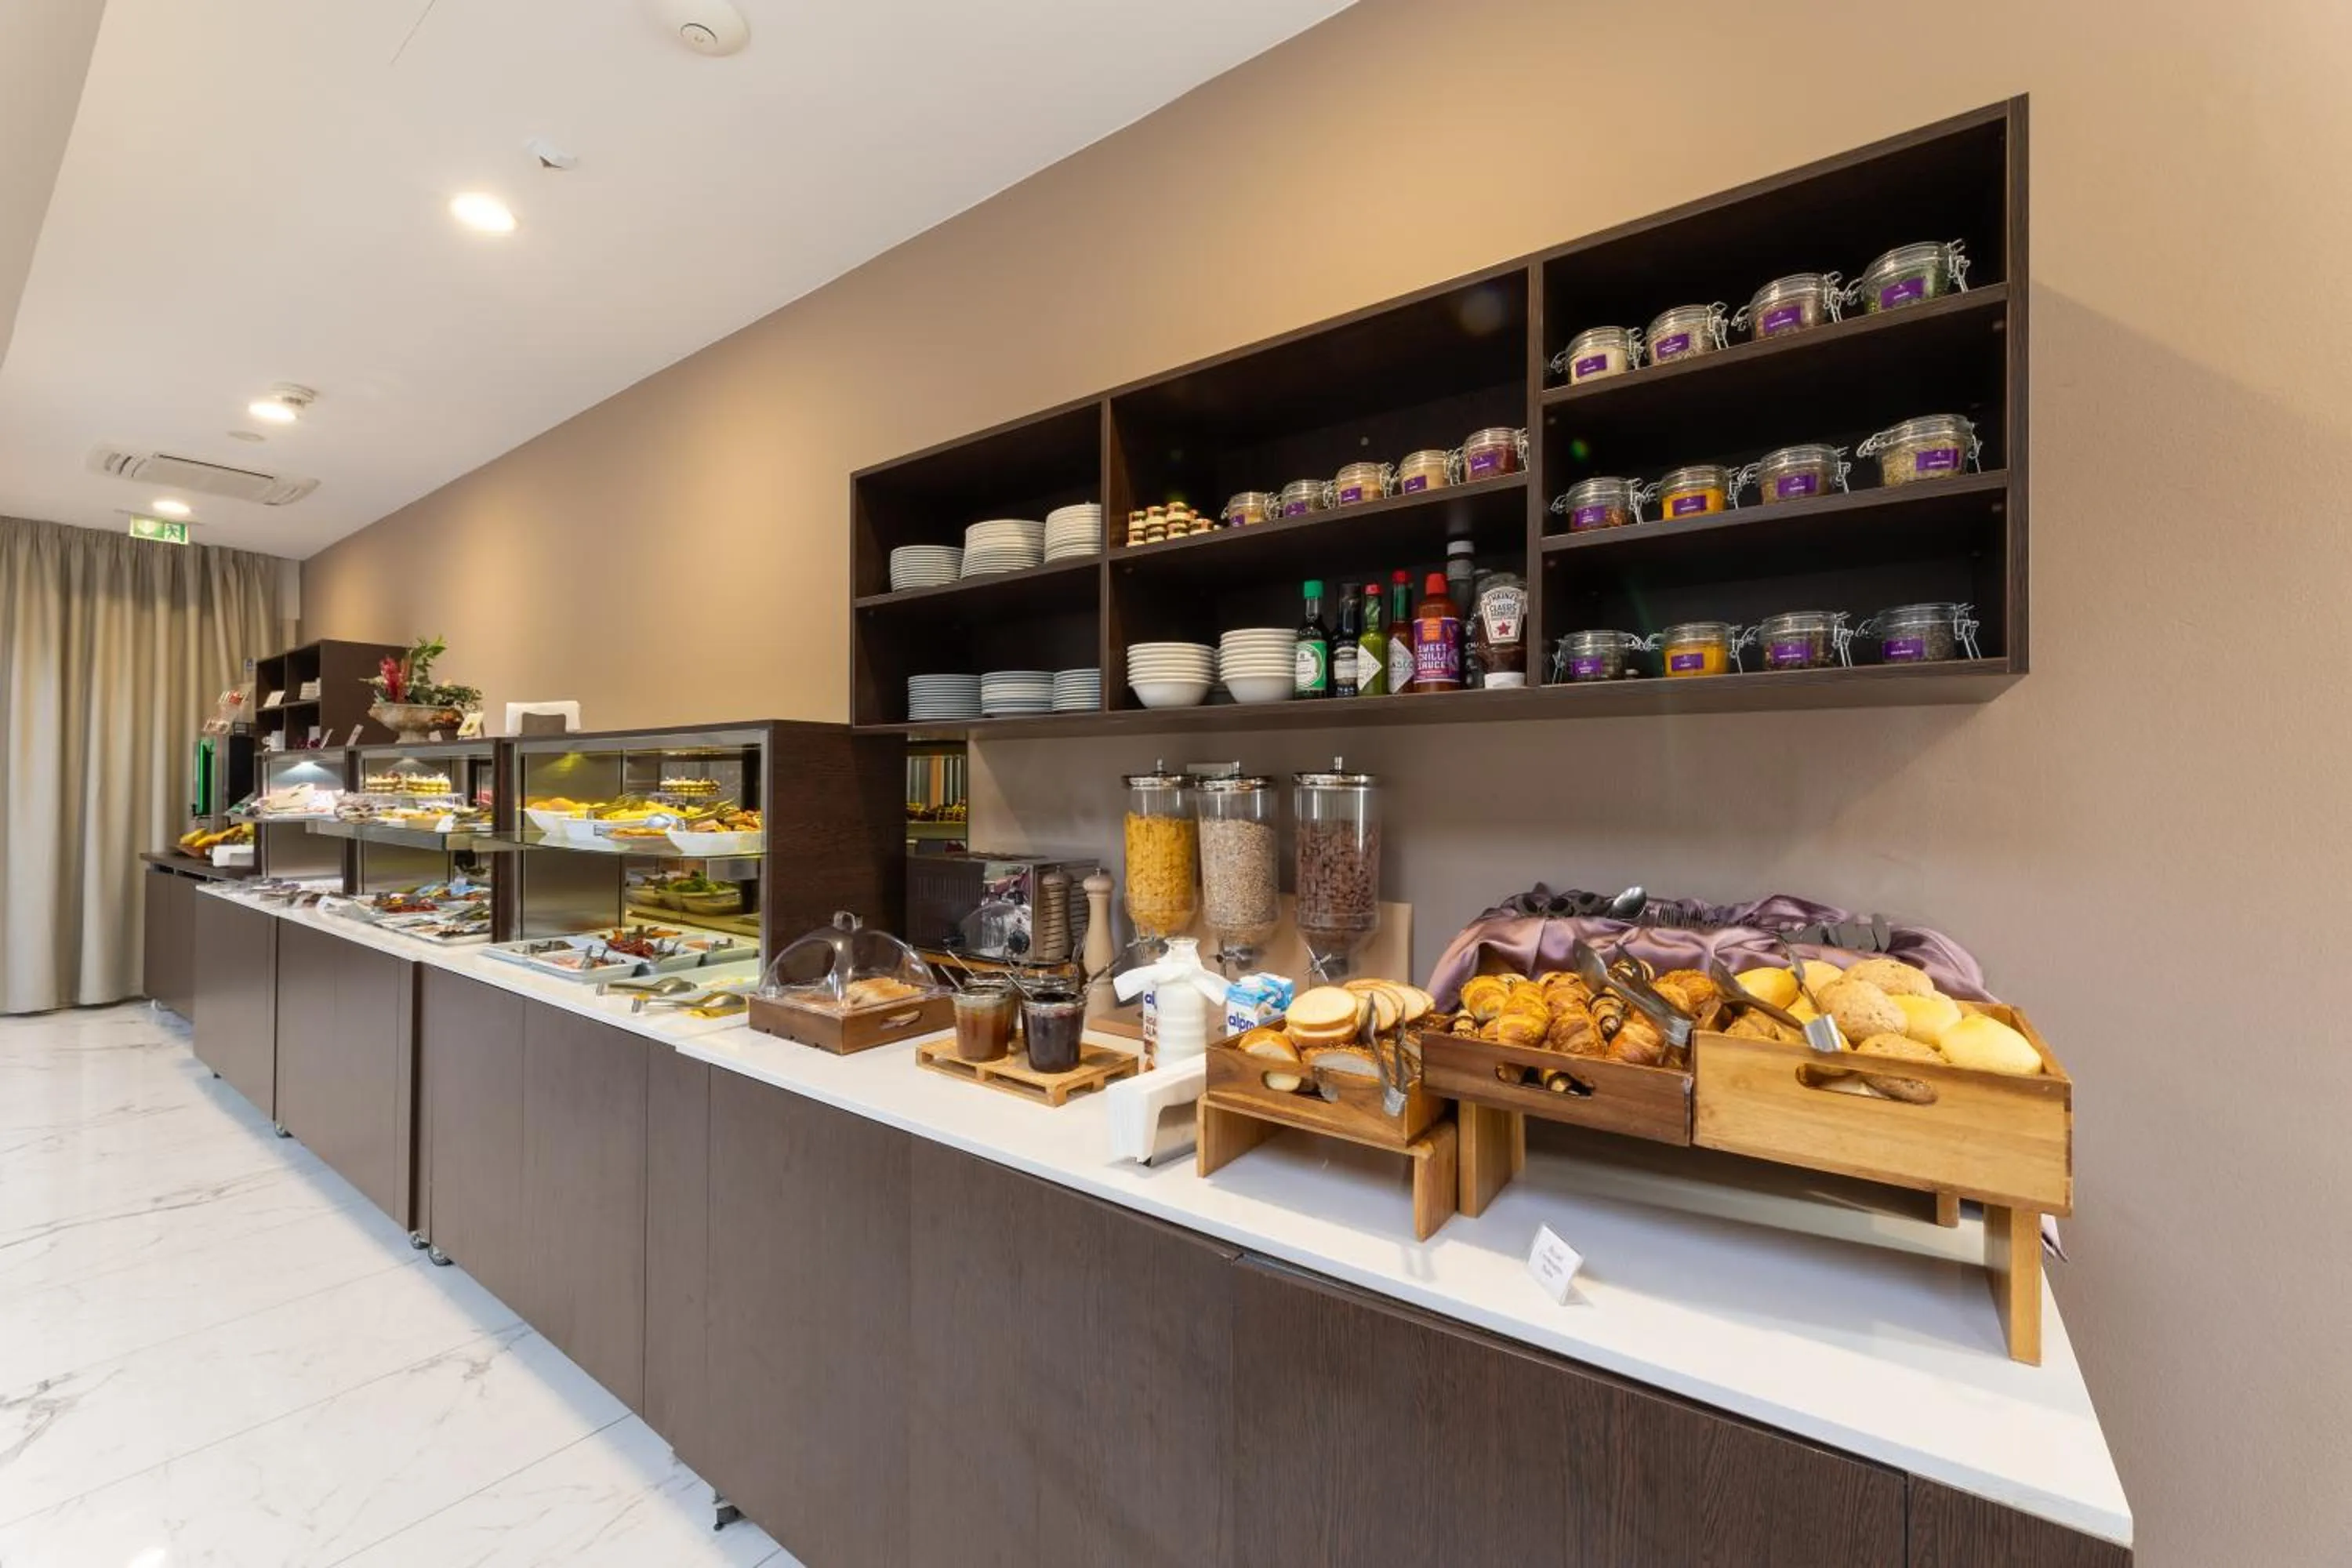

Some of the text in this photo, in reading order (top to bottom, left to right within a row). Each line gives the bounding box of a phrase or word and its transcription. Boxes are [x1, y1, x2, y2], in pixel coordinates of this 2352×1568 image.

[1417, 644, 1446, 652] SWEET
[1417, 652, 1446, 661] CHILLI
[1417, 660, 1446, 670] SAUCE
